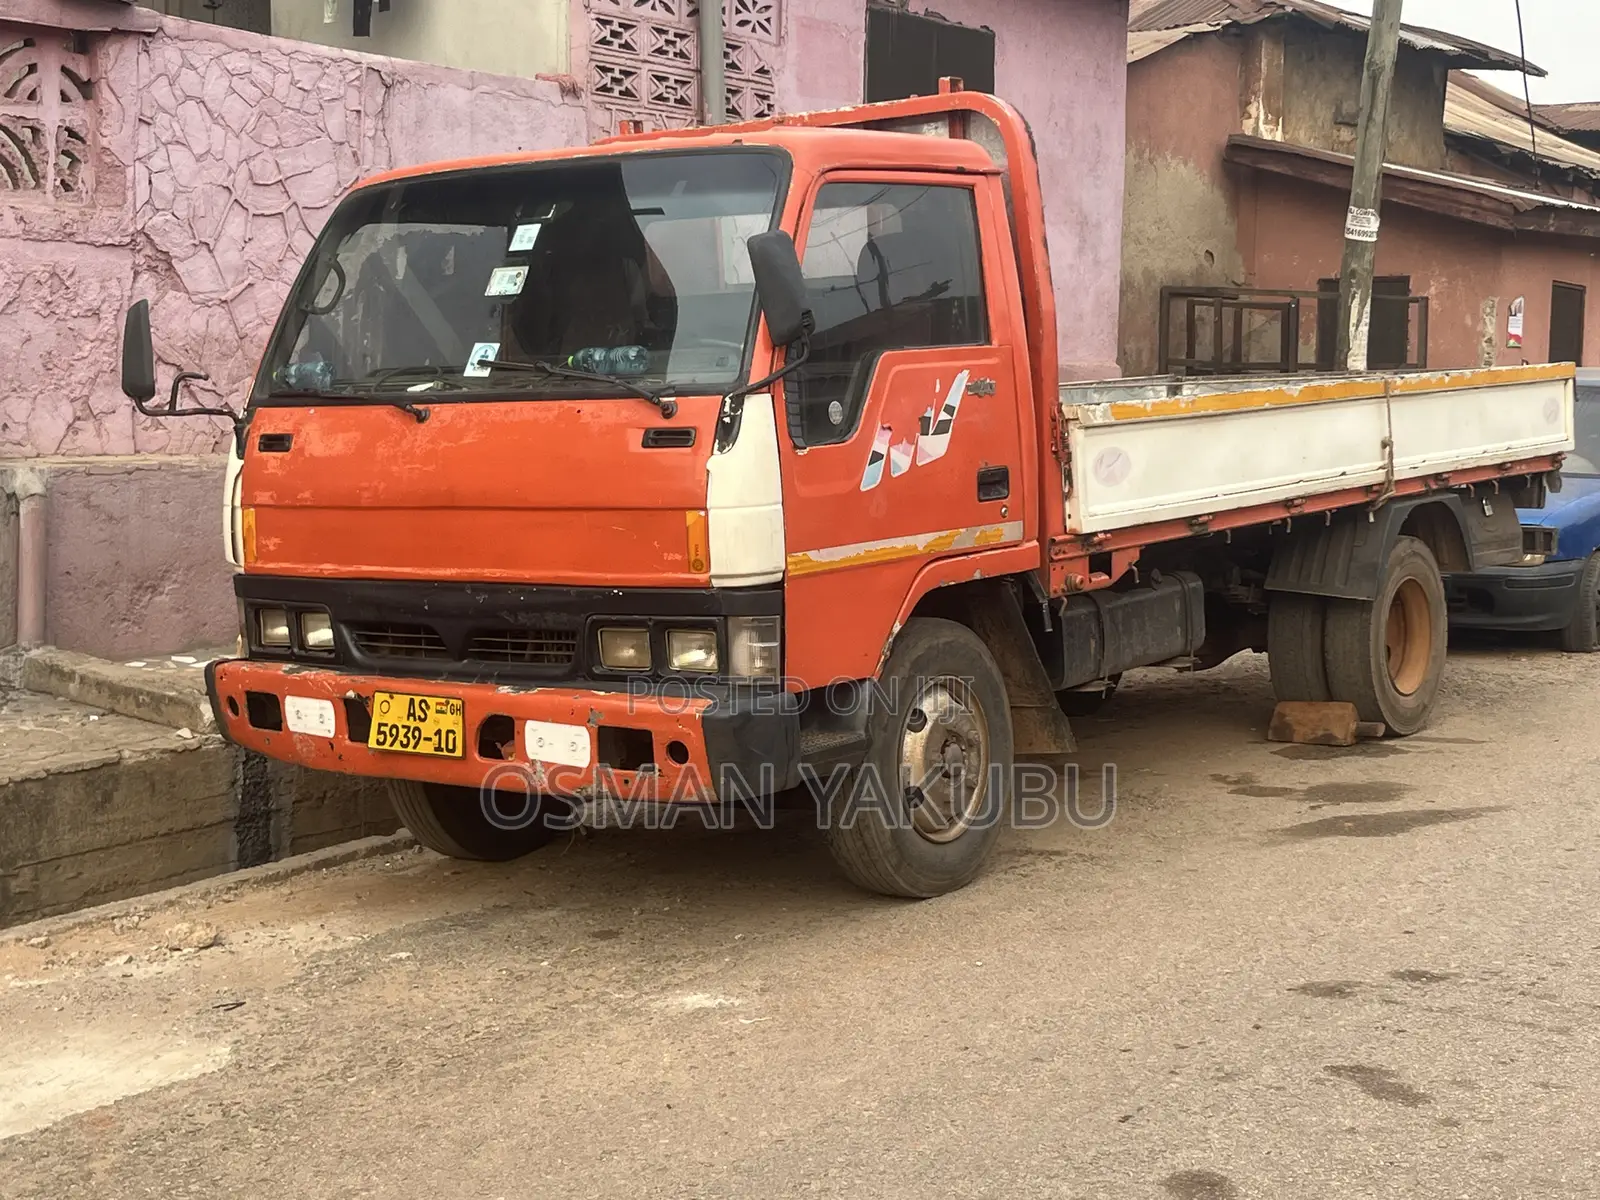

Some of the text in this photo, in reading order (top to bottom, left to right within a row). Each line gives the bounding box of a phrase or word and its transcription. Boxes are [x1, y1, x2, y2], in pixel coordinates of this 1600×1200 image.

[407, 697, 462, 722] AS GH
[375, 722, 457, 753] 5939-10
